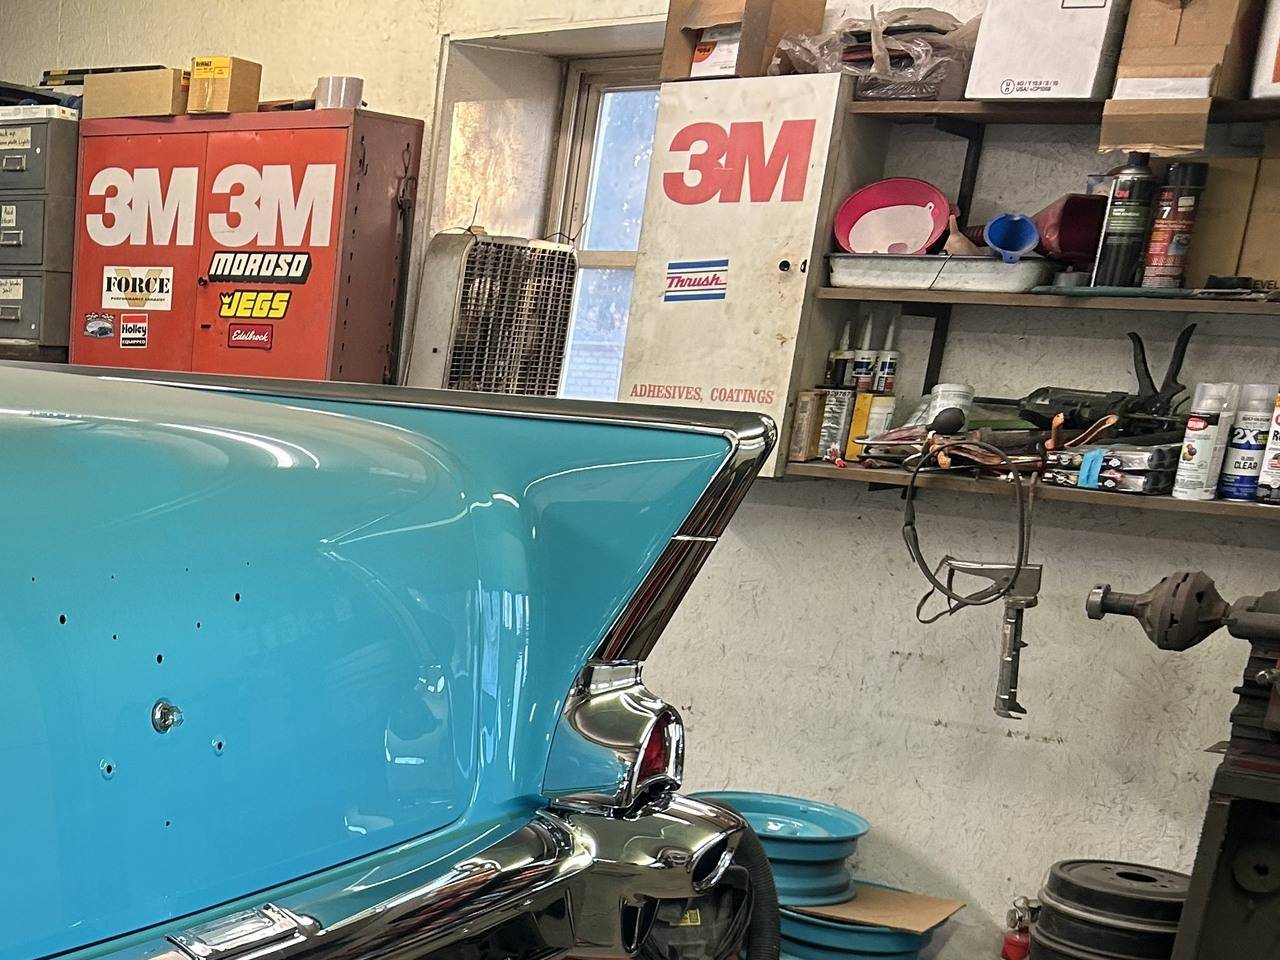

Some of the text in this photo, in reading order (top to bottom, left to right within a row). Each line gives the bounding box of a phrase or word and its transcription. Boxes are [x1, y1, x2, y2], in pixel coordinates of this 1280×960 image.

[663, 119, 816, 205] 3M
[86, 167, 199, 247] 3M
[208, 164, 337, 247] 3M
[1161, 206, 1172, 219] 7
[209, 252, 311, 280] MOROSO
[105, 276, 170, 294] FORCE
[666, 273, 724, 289] Thrush
[1254, 279, 1280, 290] EVEL
[220, 291, 291, 318] JEGS
[121, 324, 147, 337] Holley
[231, 329, 269, 342] Edelbrock
[630, 383, 775, 405] ADHESIVES, COATINGS
[1232, 428, 1260, 445] 2X
[1234, 460, 1258, 470] CLEAR
